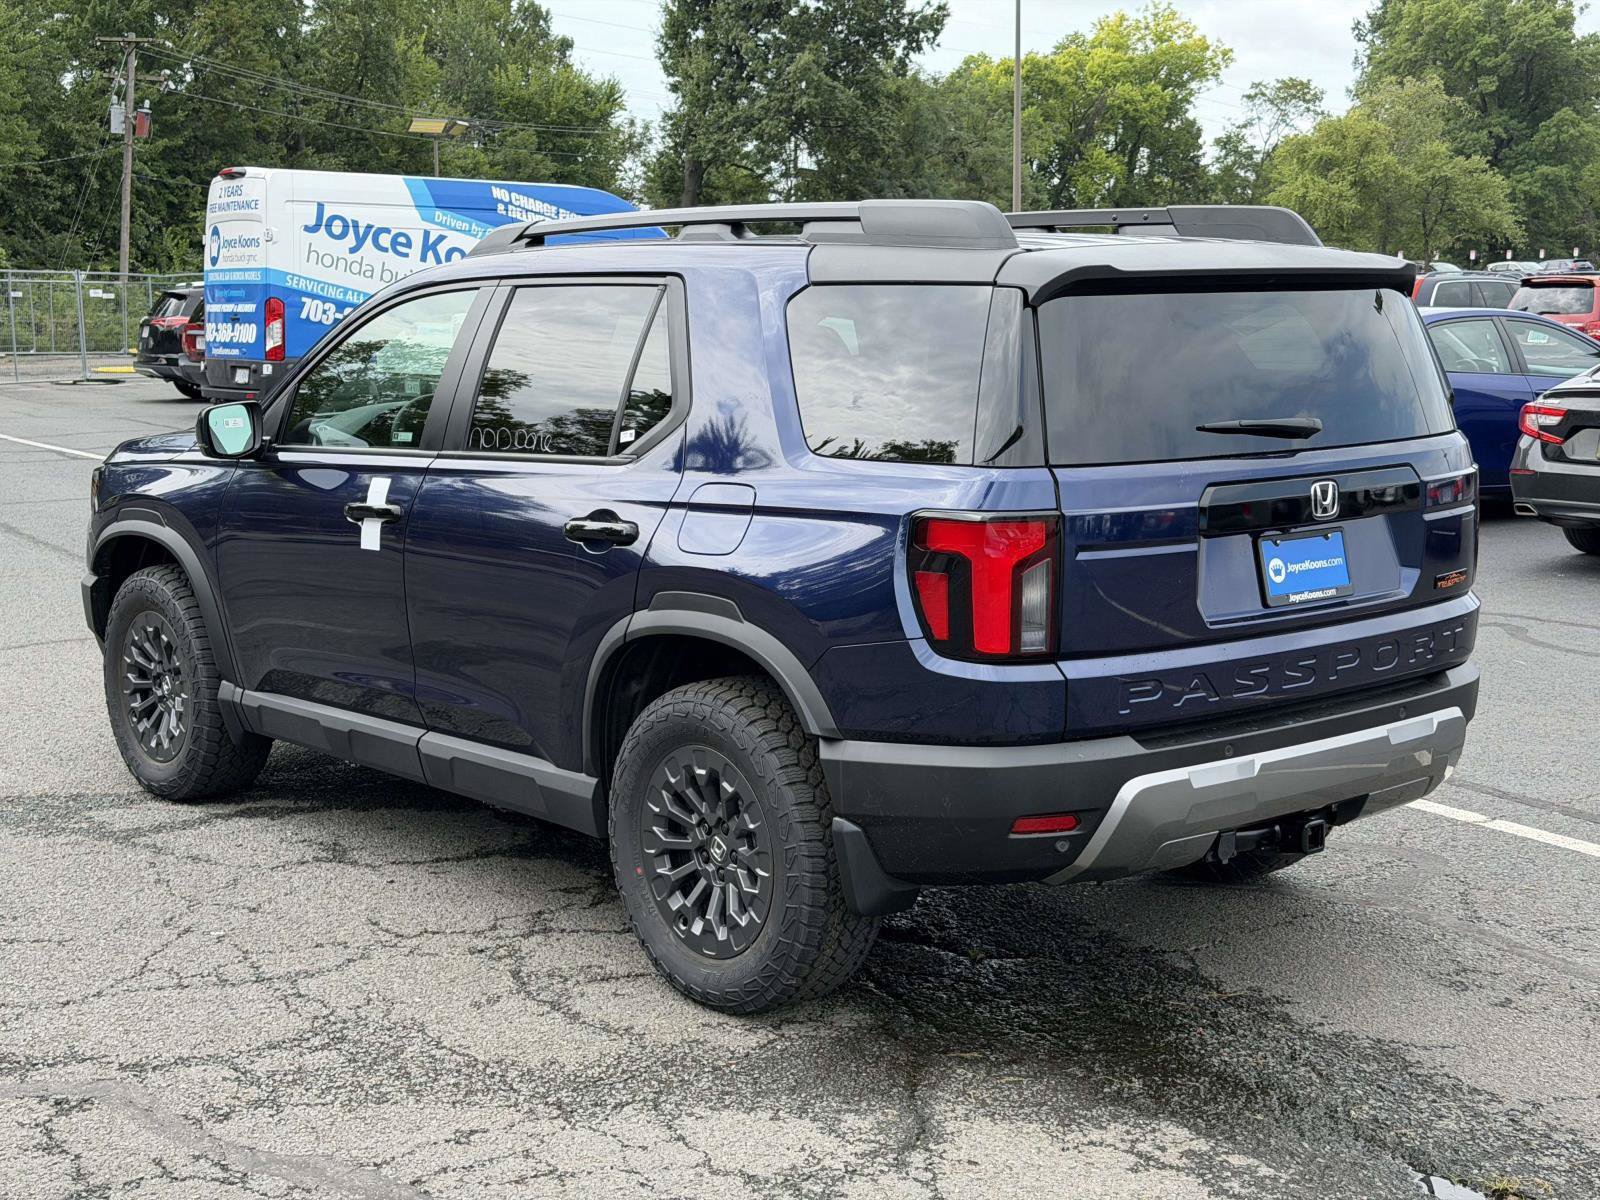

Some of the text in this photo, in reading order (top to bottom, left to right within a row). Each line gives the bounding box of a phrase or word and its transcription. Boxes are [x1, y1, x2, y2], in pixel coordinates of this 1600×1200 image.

[218, 185, 243, 199] 2 YEARS
[491, 186, 509, 202] NO
[510, 192, 558, 219] CHARGE
[218, 200, 259, 212] MAINTENANCE
[497, 203, 506, 215] &
[303, 202, 467, 265] Joyce Ko
[435, 211, 469, 231] Driven
[471, 222, 485, 240] by
[222, 234, 260, 252] Joyce Koons
[306, 242, 375, 280] honda
[286, 274, 343, 299] SERVICING
[300, 297, 354, 325] 703-
[206, 322, 257, 344] 03-368-9100
[1287, 558, 1343, 574] JoyceKoons.com
[1288, 588, 1337, 603] JoyceKoons.com
[1118, 622, 1464, 715] PASSPORT
